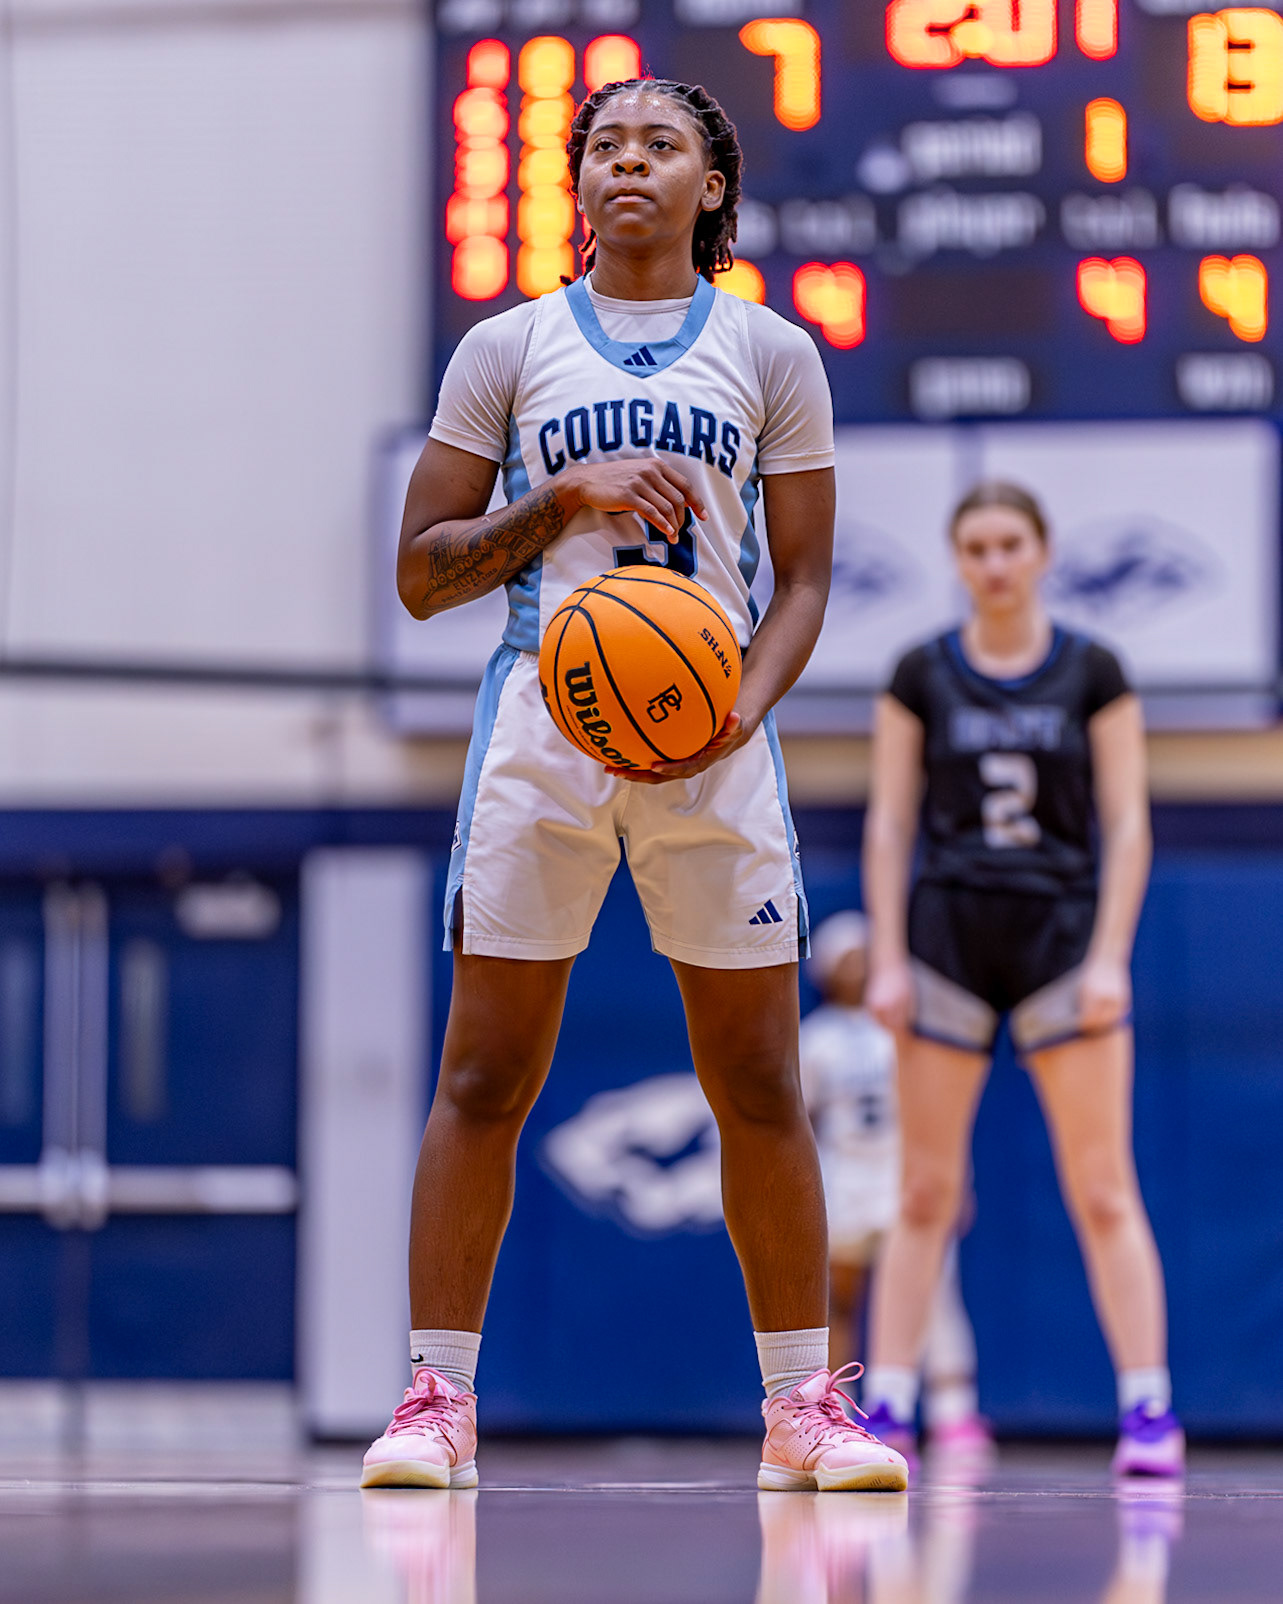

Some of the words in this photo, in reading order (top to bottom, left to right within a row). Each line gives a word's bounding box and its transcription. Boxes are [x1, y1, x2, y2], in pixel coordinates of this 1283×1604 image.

[740, 18, 821, 131] 7
[538, 398, 740, 479] COUGARS
[565, 661, 640, 768] Wilson
[979, 752, 1042, 849] 2
